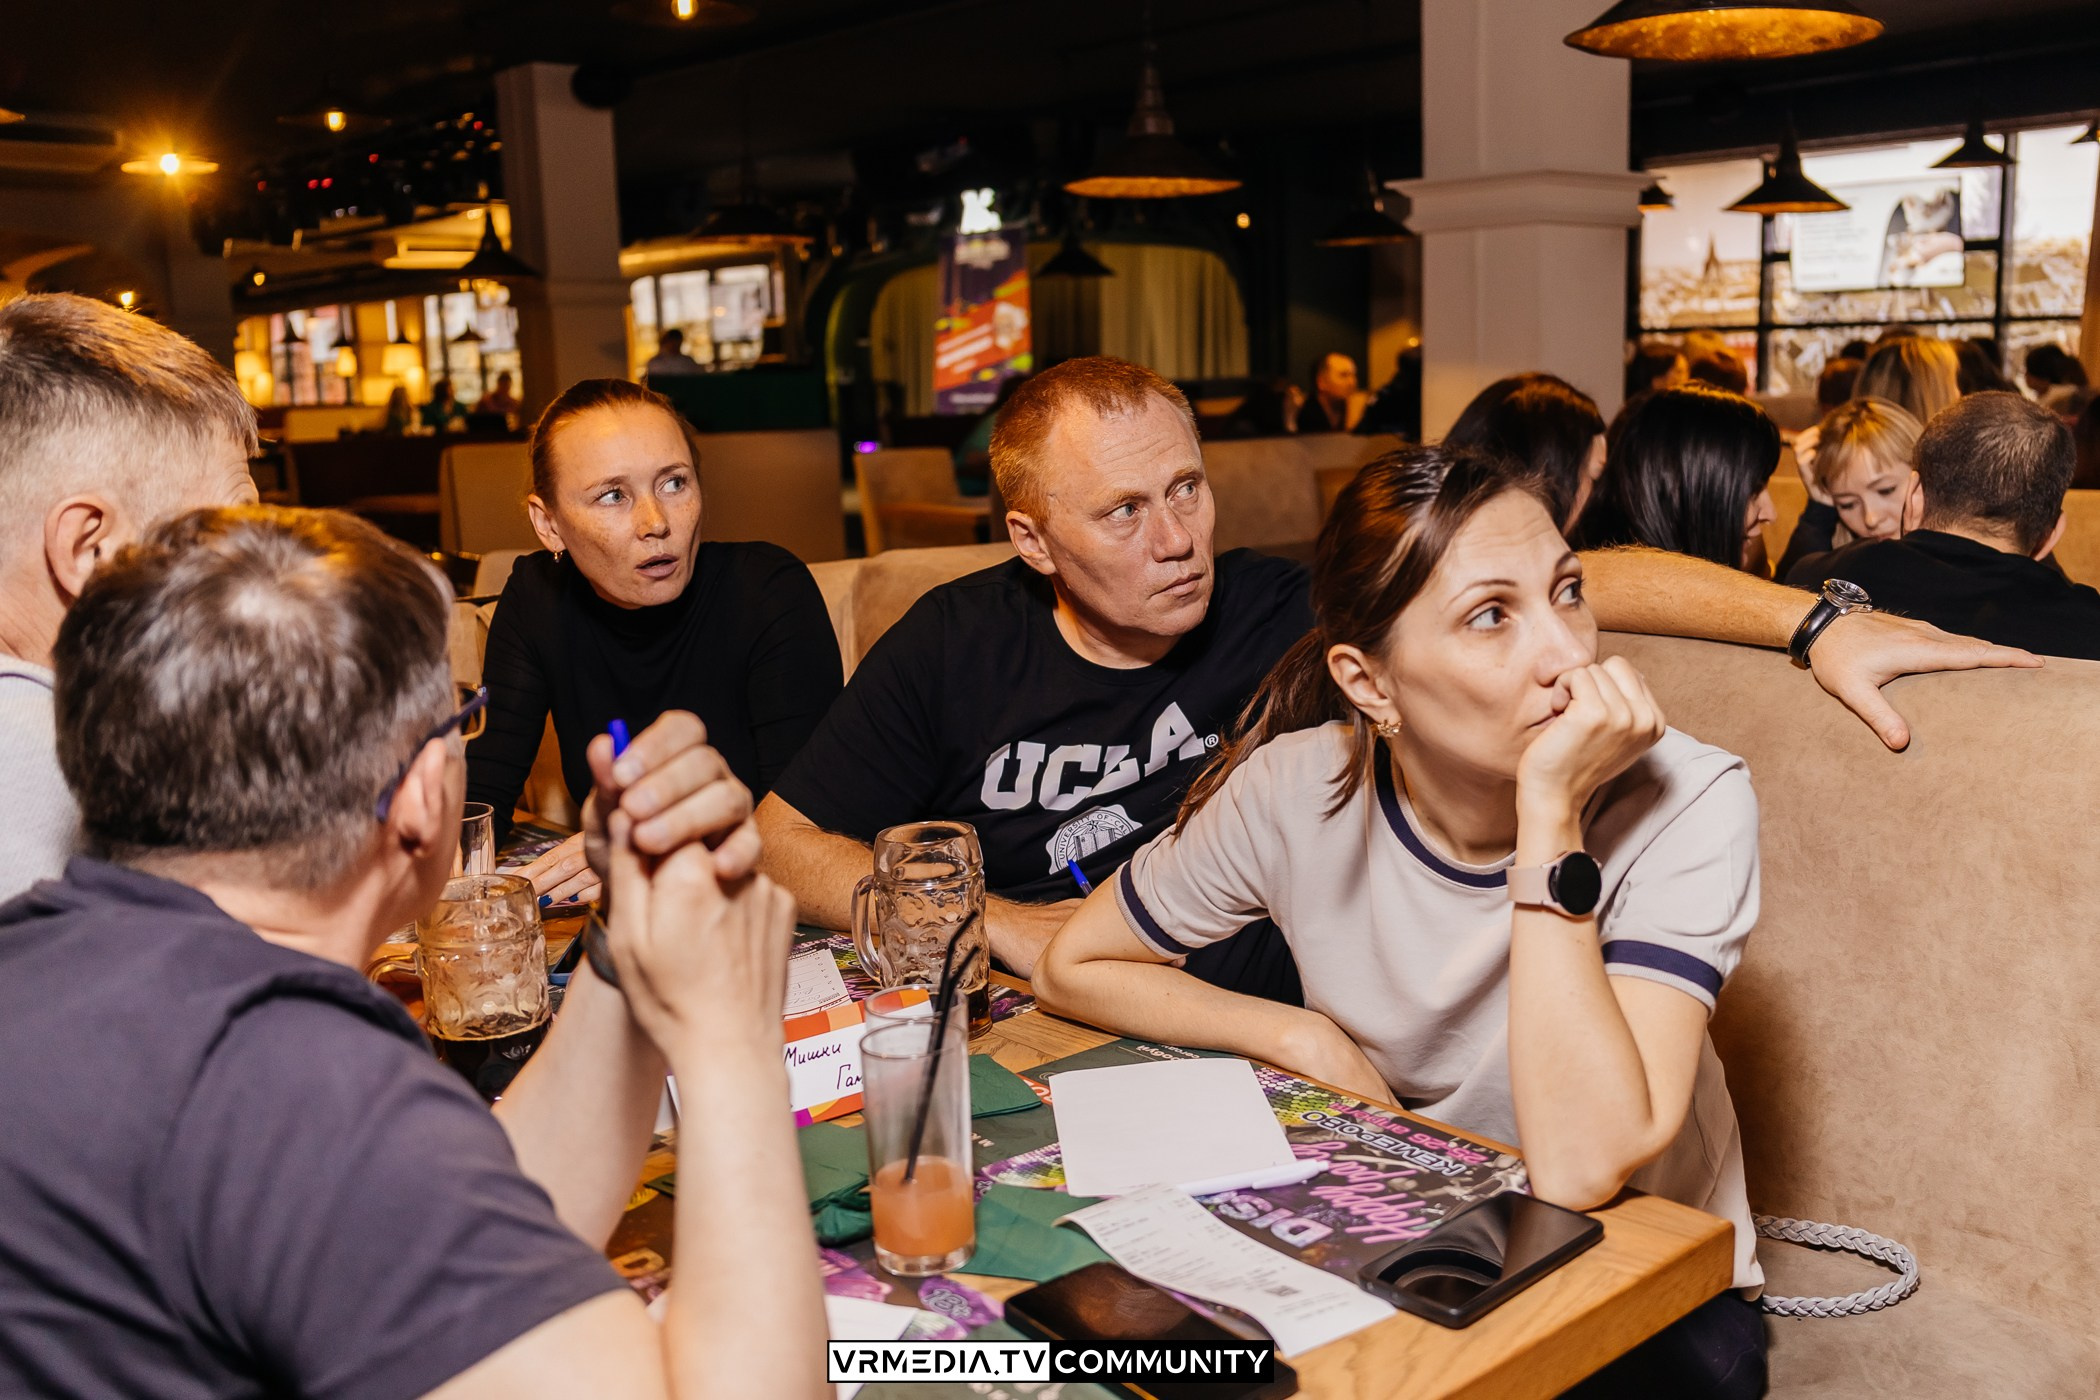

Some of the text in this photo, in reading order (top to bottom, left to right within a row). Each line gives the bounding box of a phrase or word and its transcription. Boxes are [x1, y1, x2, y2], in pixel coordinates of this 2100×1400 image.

[1060, 815, 1090, 860] UNIVERSITY
[1114, 820, 1128, 835] CAL
[783, 1043, 842, 1068] Мишки
[836, 1063, 864, 1090] Гам
[1301, 1111, 1467, 1177] КЕМЕРОВО
[1309, 1182, 1431, 1244] Happy
[922, 1289, 972, 1318] 18+
